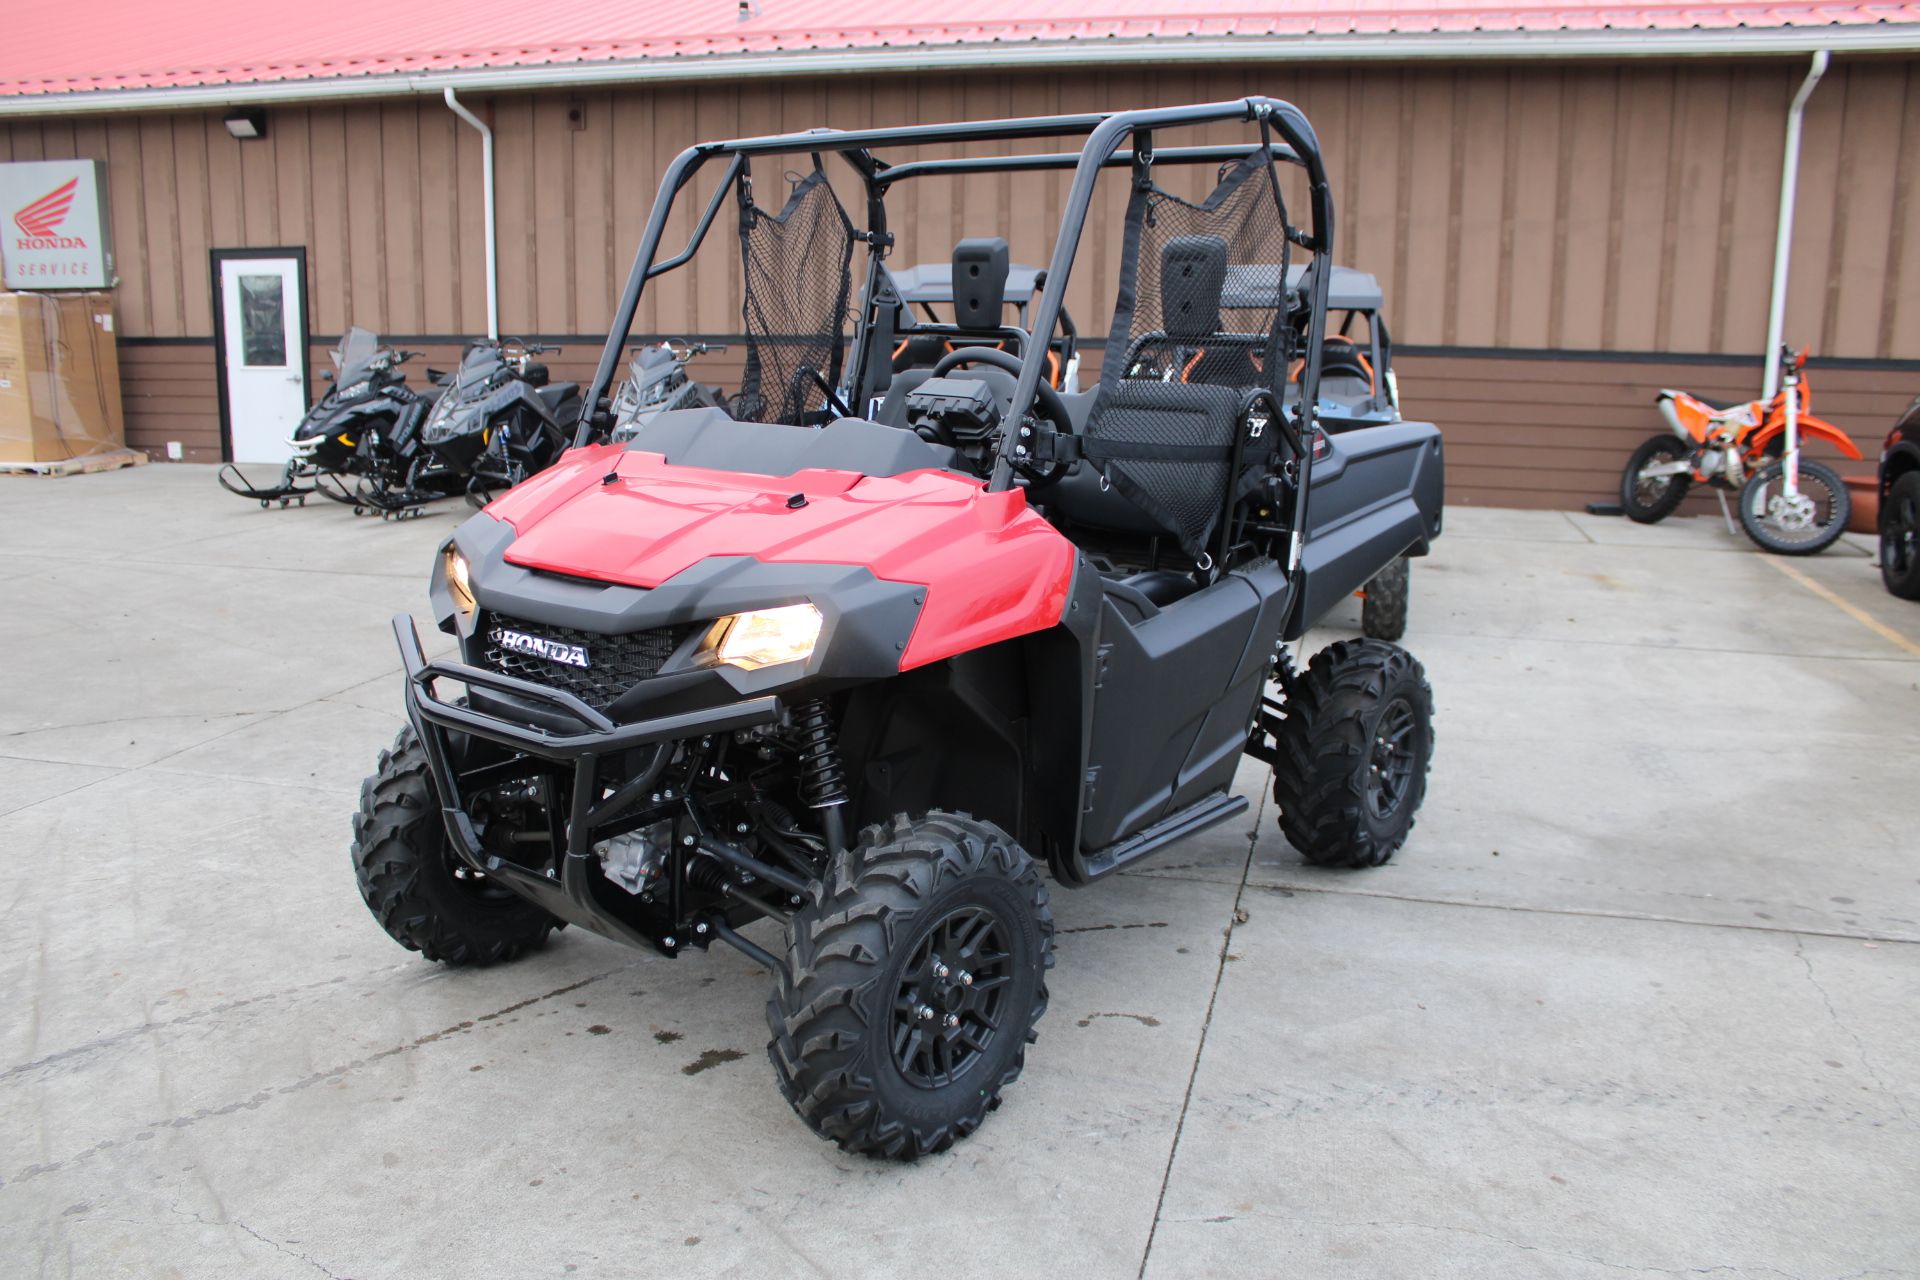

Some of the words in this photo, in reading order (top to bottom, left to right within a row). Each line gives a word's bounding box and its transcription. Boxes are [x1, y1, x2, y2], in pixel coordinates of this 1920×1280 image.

[17, 237, 88, 250] HONDA
[18, 262, 89, 276] SERVICE
[501, 630, 588, 667] HONDA
